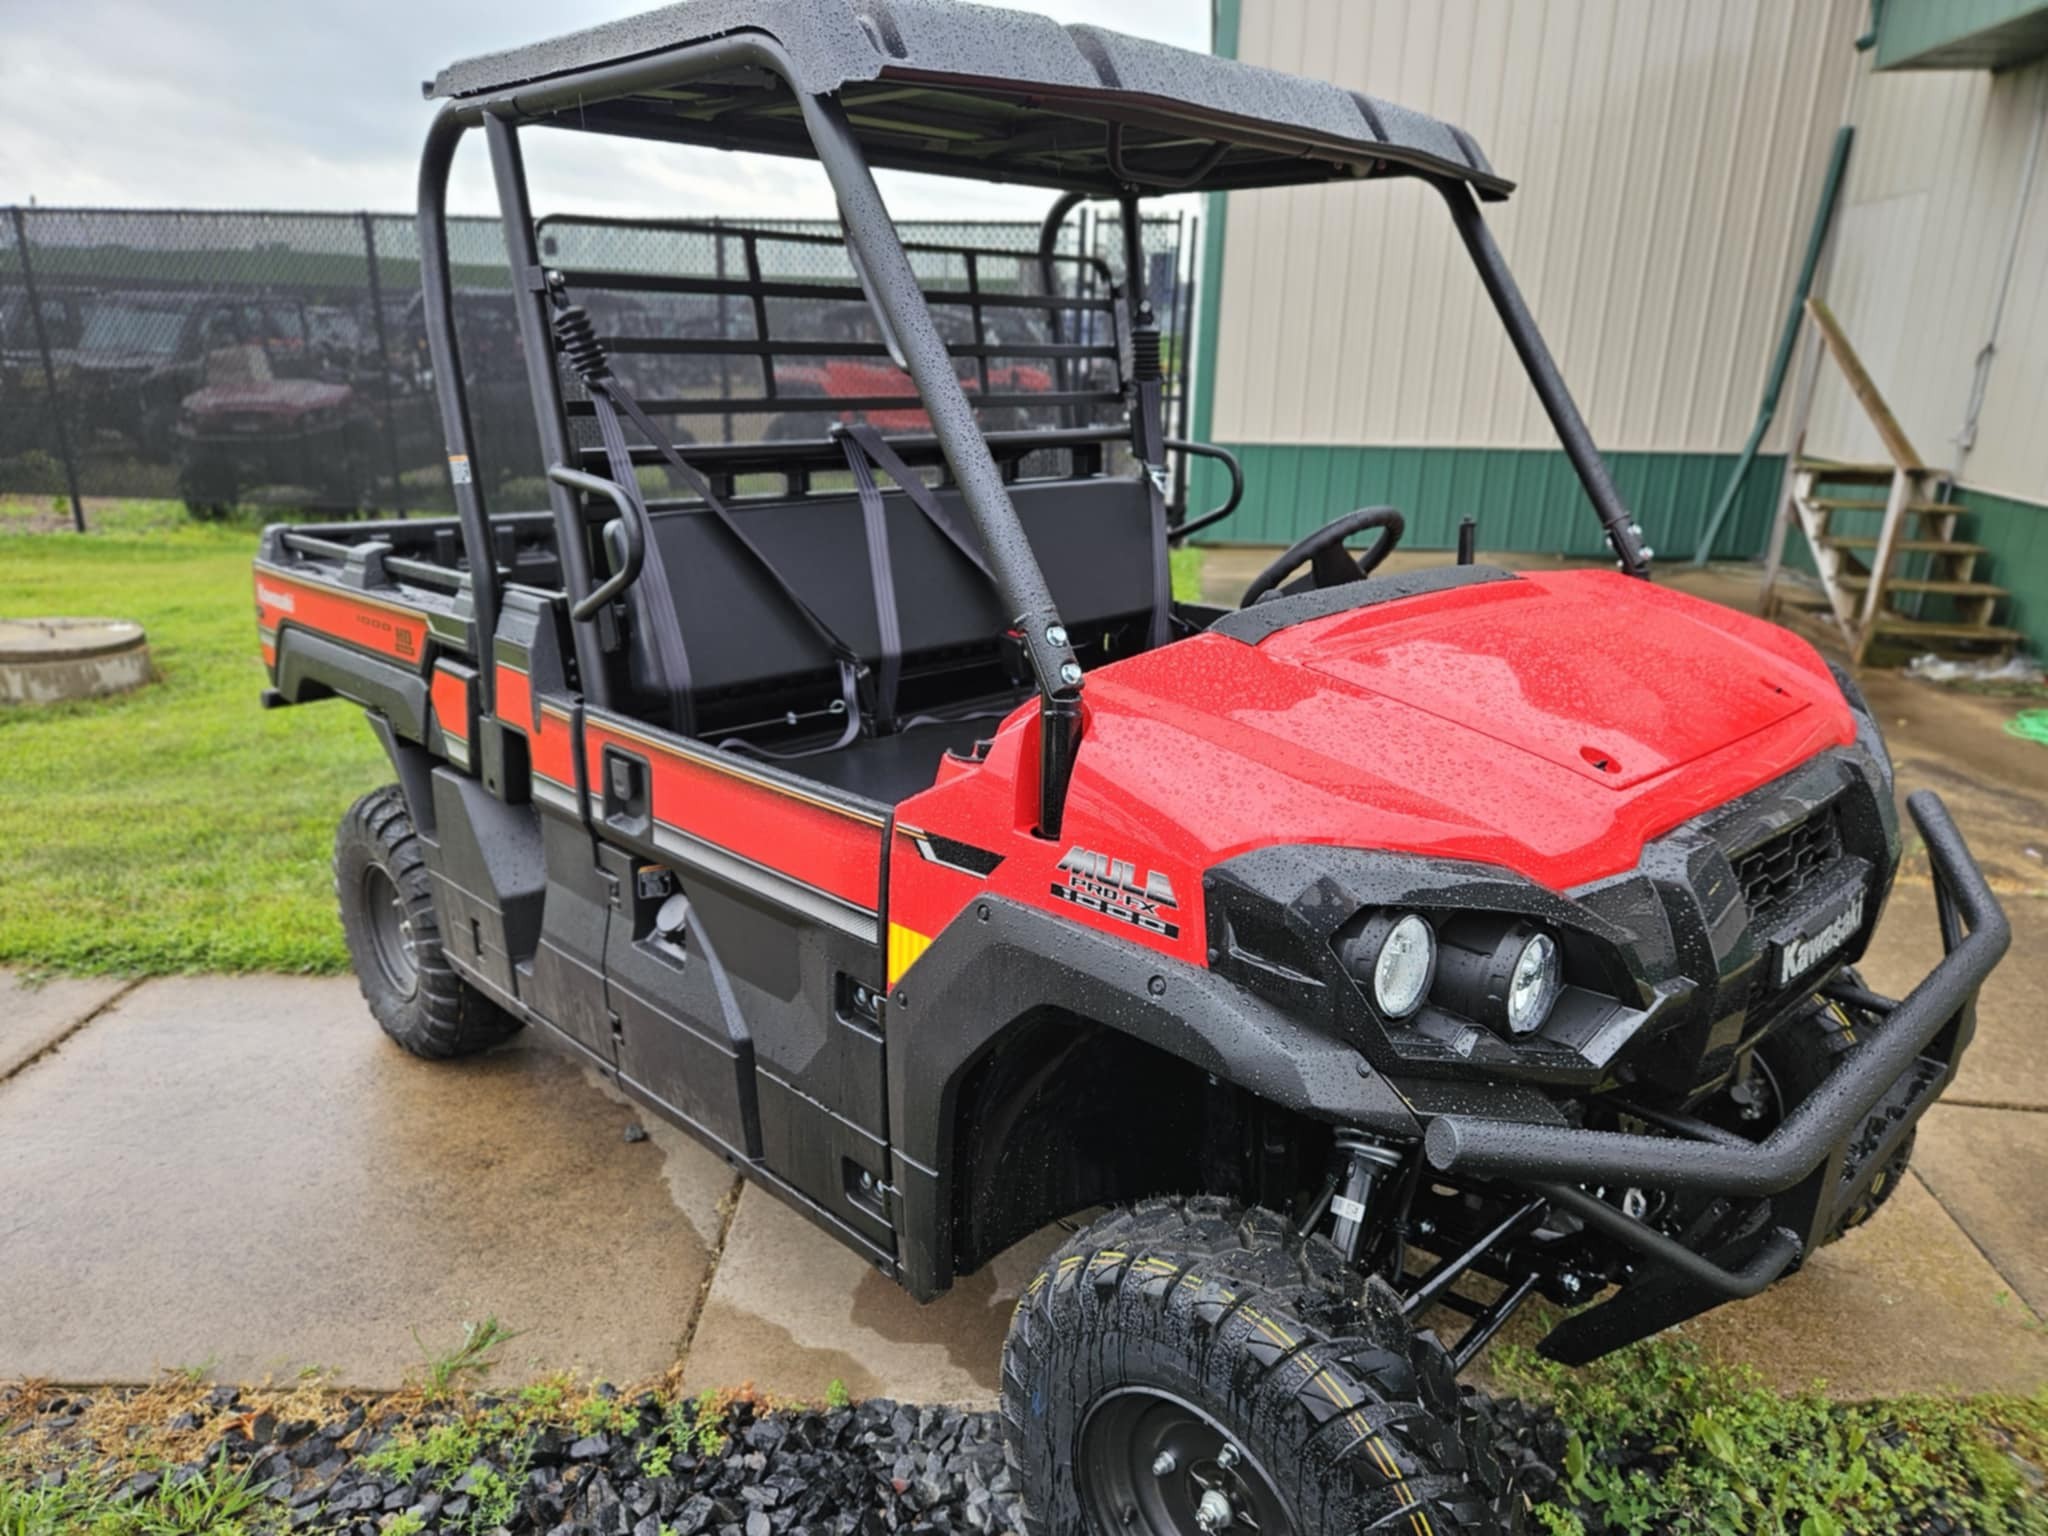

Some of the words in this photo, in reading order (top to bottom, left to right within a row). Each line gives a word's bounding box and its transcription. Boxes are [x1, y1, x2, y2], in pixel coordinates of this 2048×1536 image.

[1062, 887, 1167, 934] 1000
[1070, 876, 1118, 901] PRO
[1125, 895, 1159, 915] FX
[1781, 889, 1865, 984] Kawasaki
